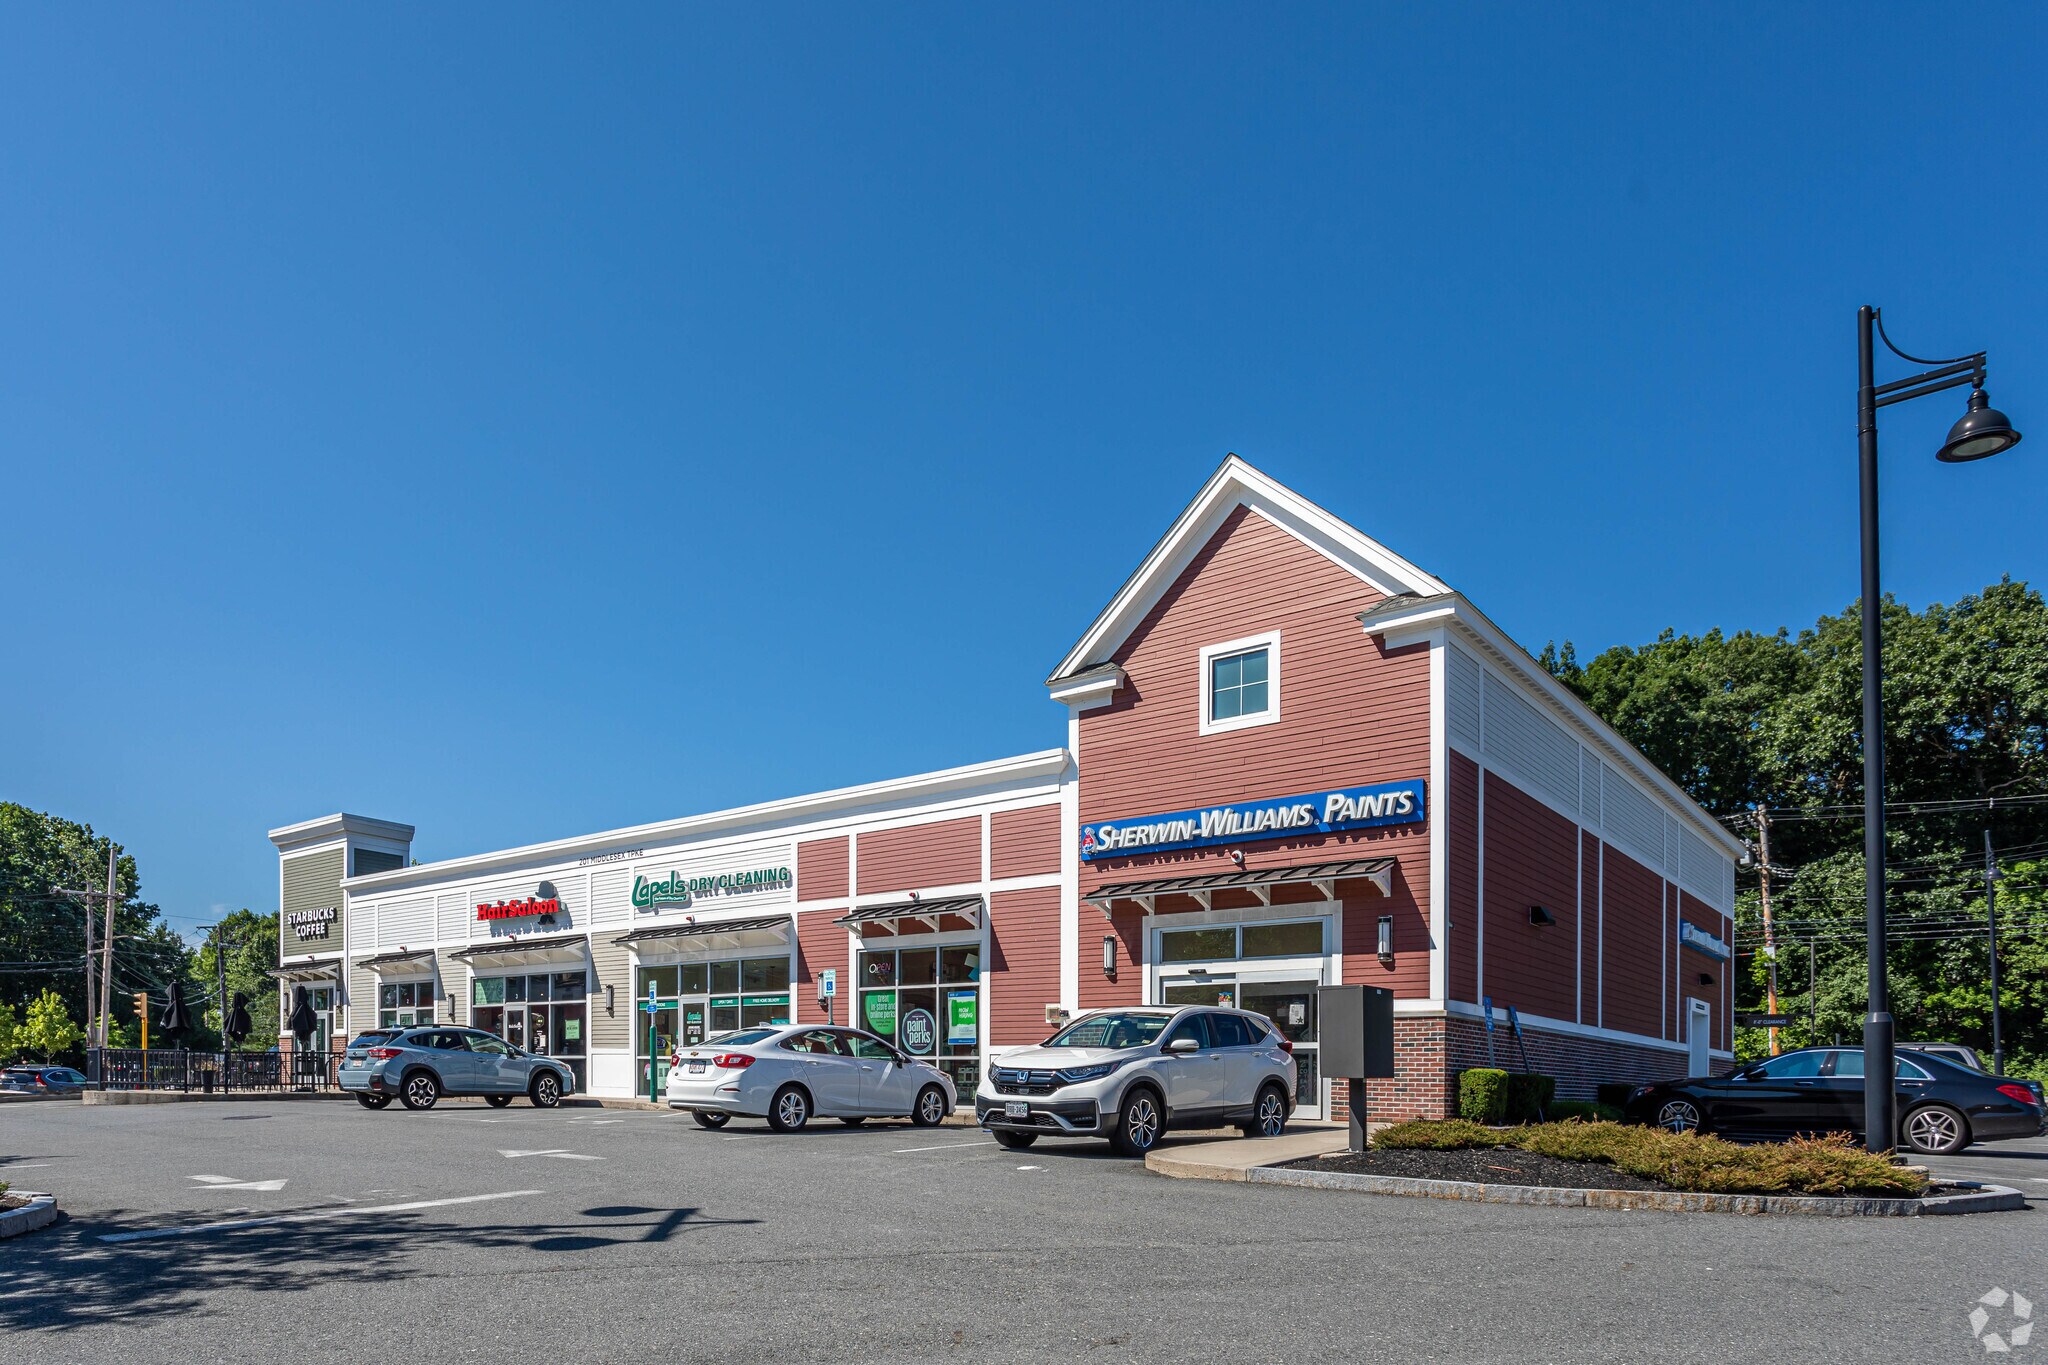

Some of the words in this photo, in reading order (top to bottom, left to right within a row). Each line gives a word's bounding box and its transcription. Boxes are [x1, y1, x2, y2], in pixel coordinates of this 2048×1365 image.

[1323, 790, 1415, 826] PAINTS
[579, 858, 590, 866] 201
[591, 851, 626, 864] MIDDLESEX
[627, 848, 644, 858] TPKE
[631, 870, 686, 908] Lapels
[690, 876, 715, 892] DRY
[719, 867, 788, 888] CLEANING
[287, 907, 334, 925] STARBUCKS
[476, 897, 559, 921] HairSaloon
[296, 922, 326, 937] COFFEE
[868, 962, 892, 974] OPEN
[907, 1018, 927, 1034] paint
[909, 1031, 931, 1045] perks
